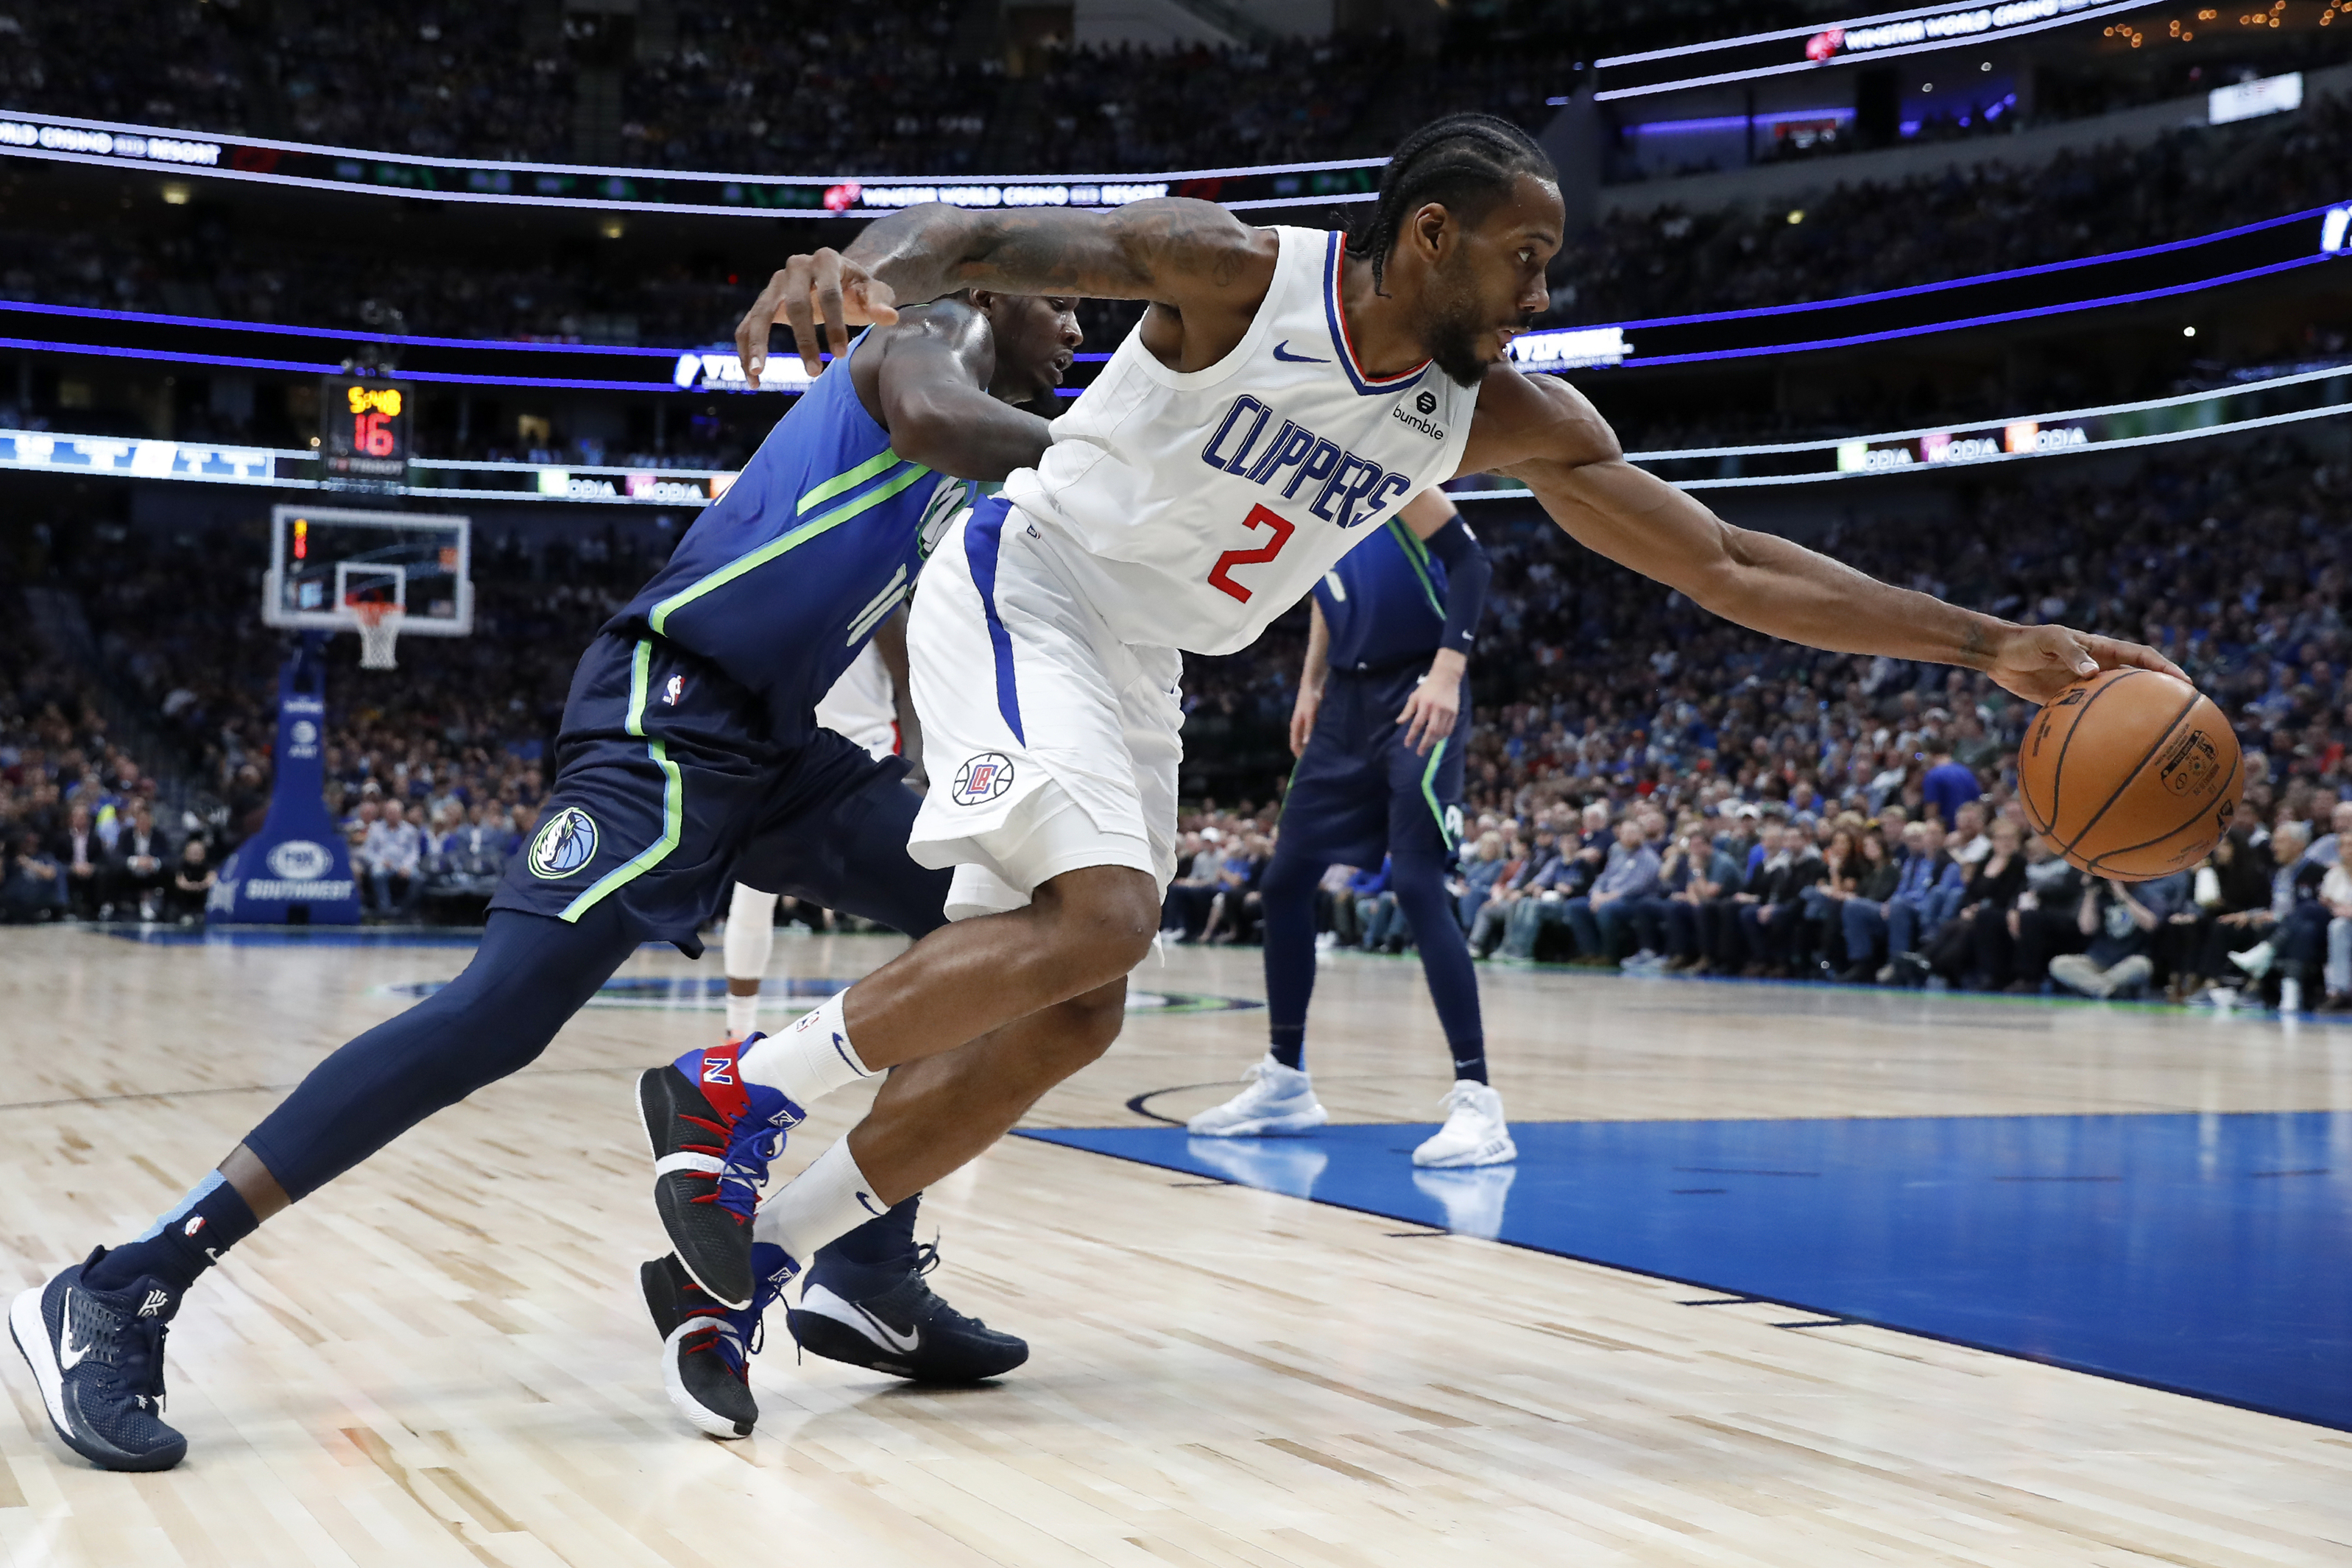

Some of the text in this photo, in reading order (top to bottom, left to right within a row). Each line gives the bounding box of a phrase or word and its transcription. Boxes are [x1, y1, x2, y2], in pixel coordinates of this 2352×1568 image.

[1925, 9, 1992, 37] WORLD
[147, 137, 221, 166] RESORT
[938, 186, 1002, 206] WORLD
[1002, 186, 1068, 206] CASINO
[1101, 184, 1169, 205] RESORT
[354, 414, 393, 456] 16
[1393, 403, 1444, 440] bumble
[1201, 394, 1410, 529] CLIPPERS
[1208, 503, 1295, 604] 2
[244, 878, 354, 901] SOUTHWEST
